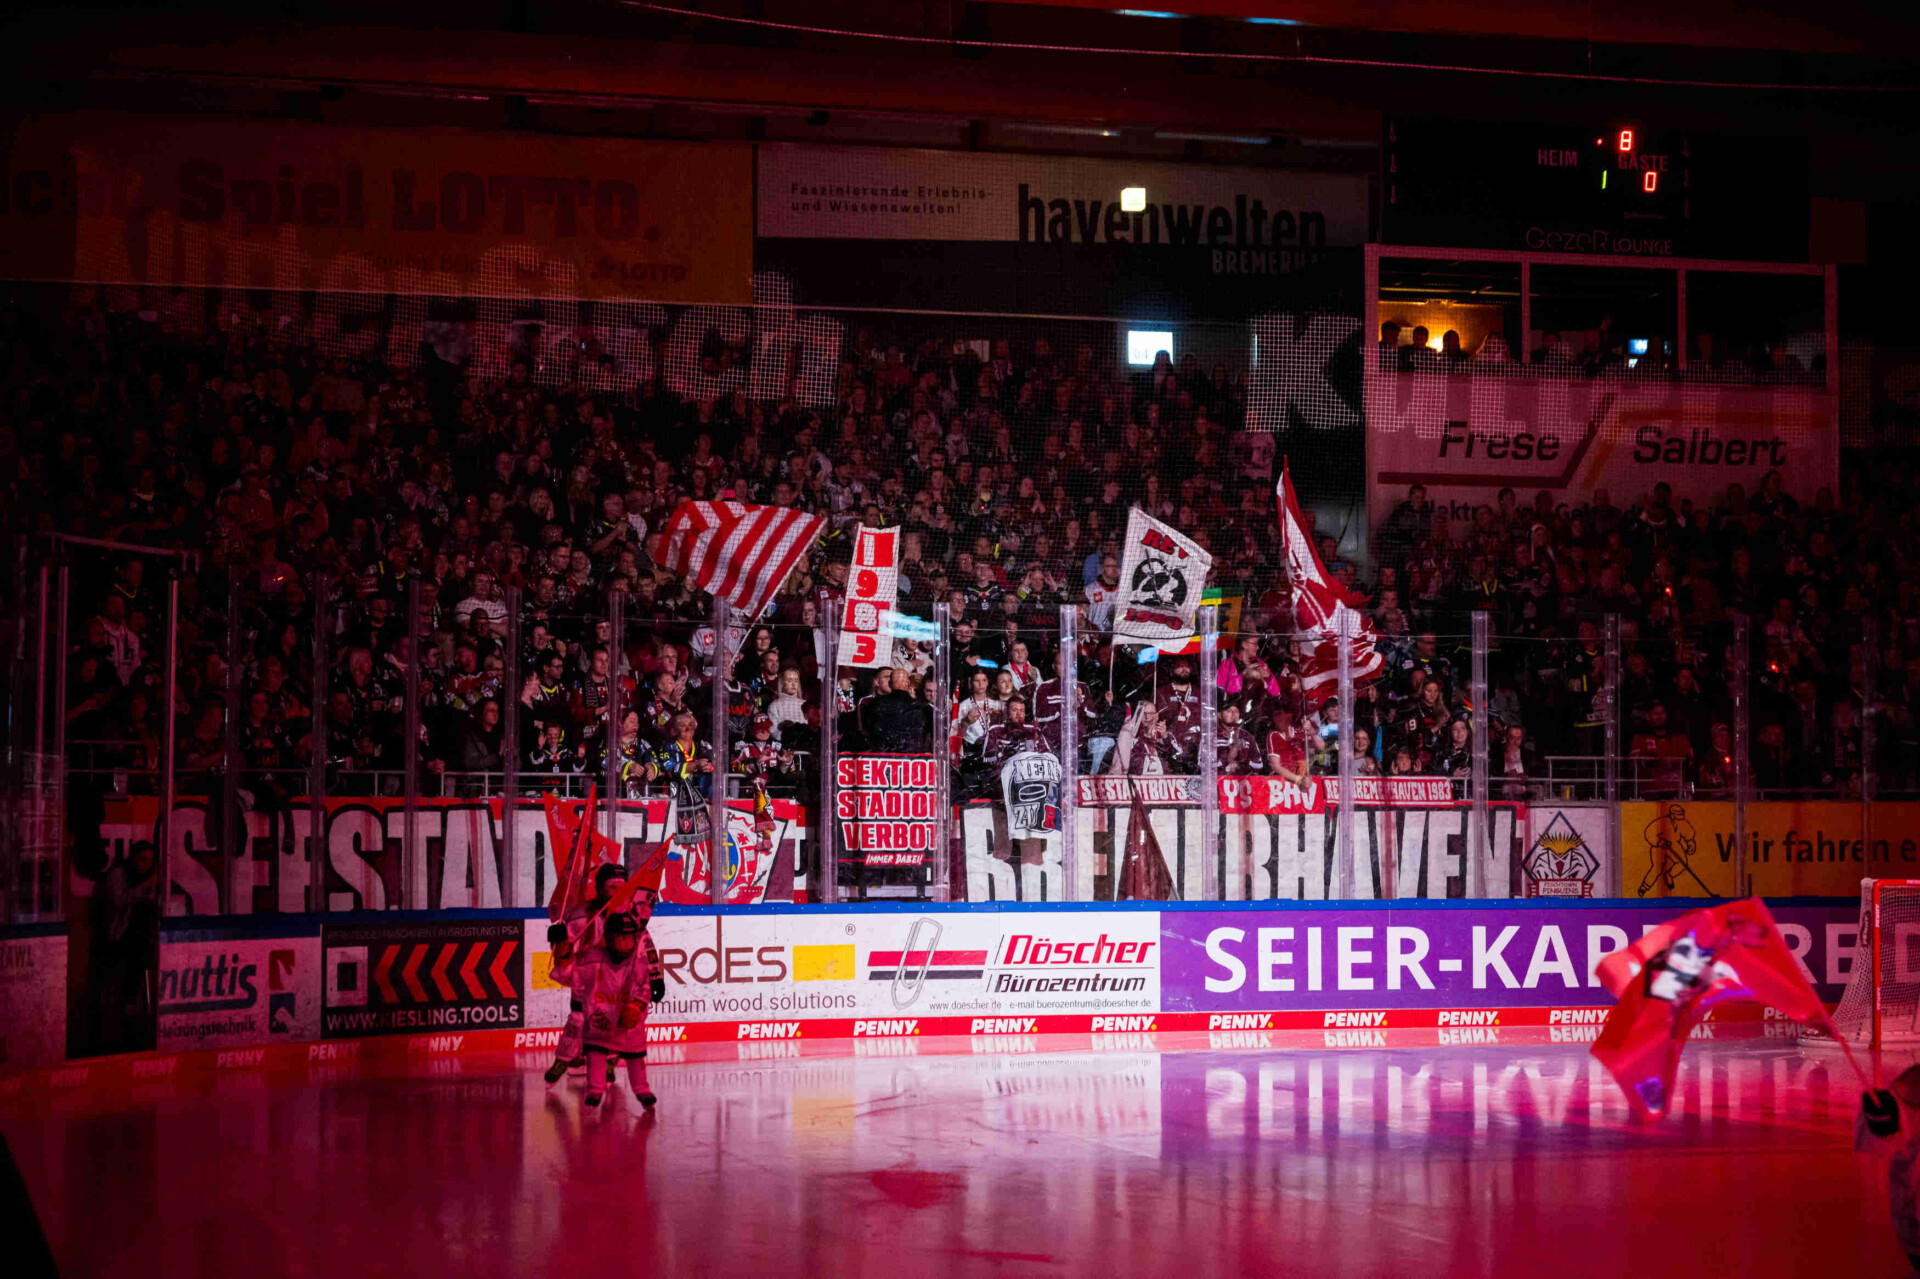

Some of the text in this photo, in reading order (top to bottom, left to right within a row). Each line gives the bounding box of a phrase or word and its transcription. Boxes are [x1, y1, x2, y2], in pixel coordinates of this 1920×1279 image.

[1619, 130, 1632, 151] 8
[1537, 149, 1578, 167] HEIM
[1645, 171, 1657, 192] 0
[180, 160, 364, 225] Spiel
[791, 200, 822, 213] und
[1019, 184, 1326, 247] havenwelten
[1439, 421, 1788, 467] Frese Salbert
[1427, 779, 1451, 800] 1983
[1783, 831, 1890, 863] fahren
[1542, 887, 1579, 895] PINGUINS
[501, 925, 519, 935] PSA
[1003, 933, 1156, 965] Döscher
[995, 973, 1146, 993] Bürozentrum
[713, 993, 763, 1011] wood
[769, 992, 856, 1010] solutions
[514, 1029, 562, 1048] PENN
